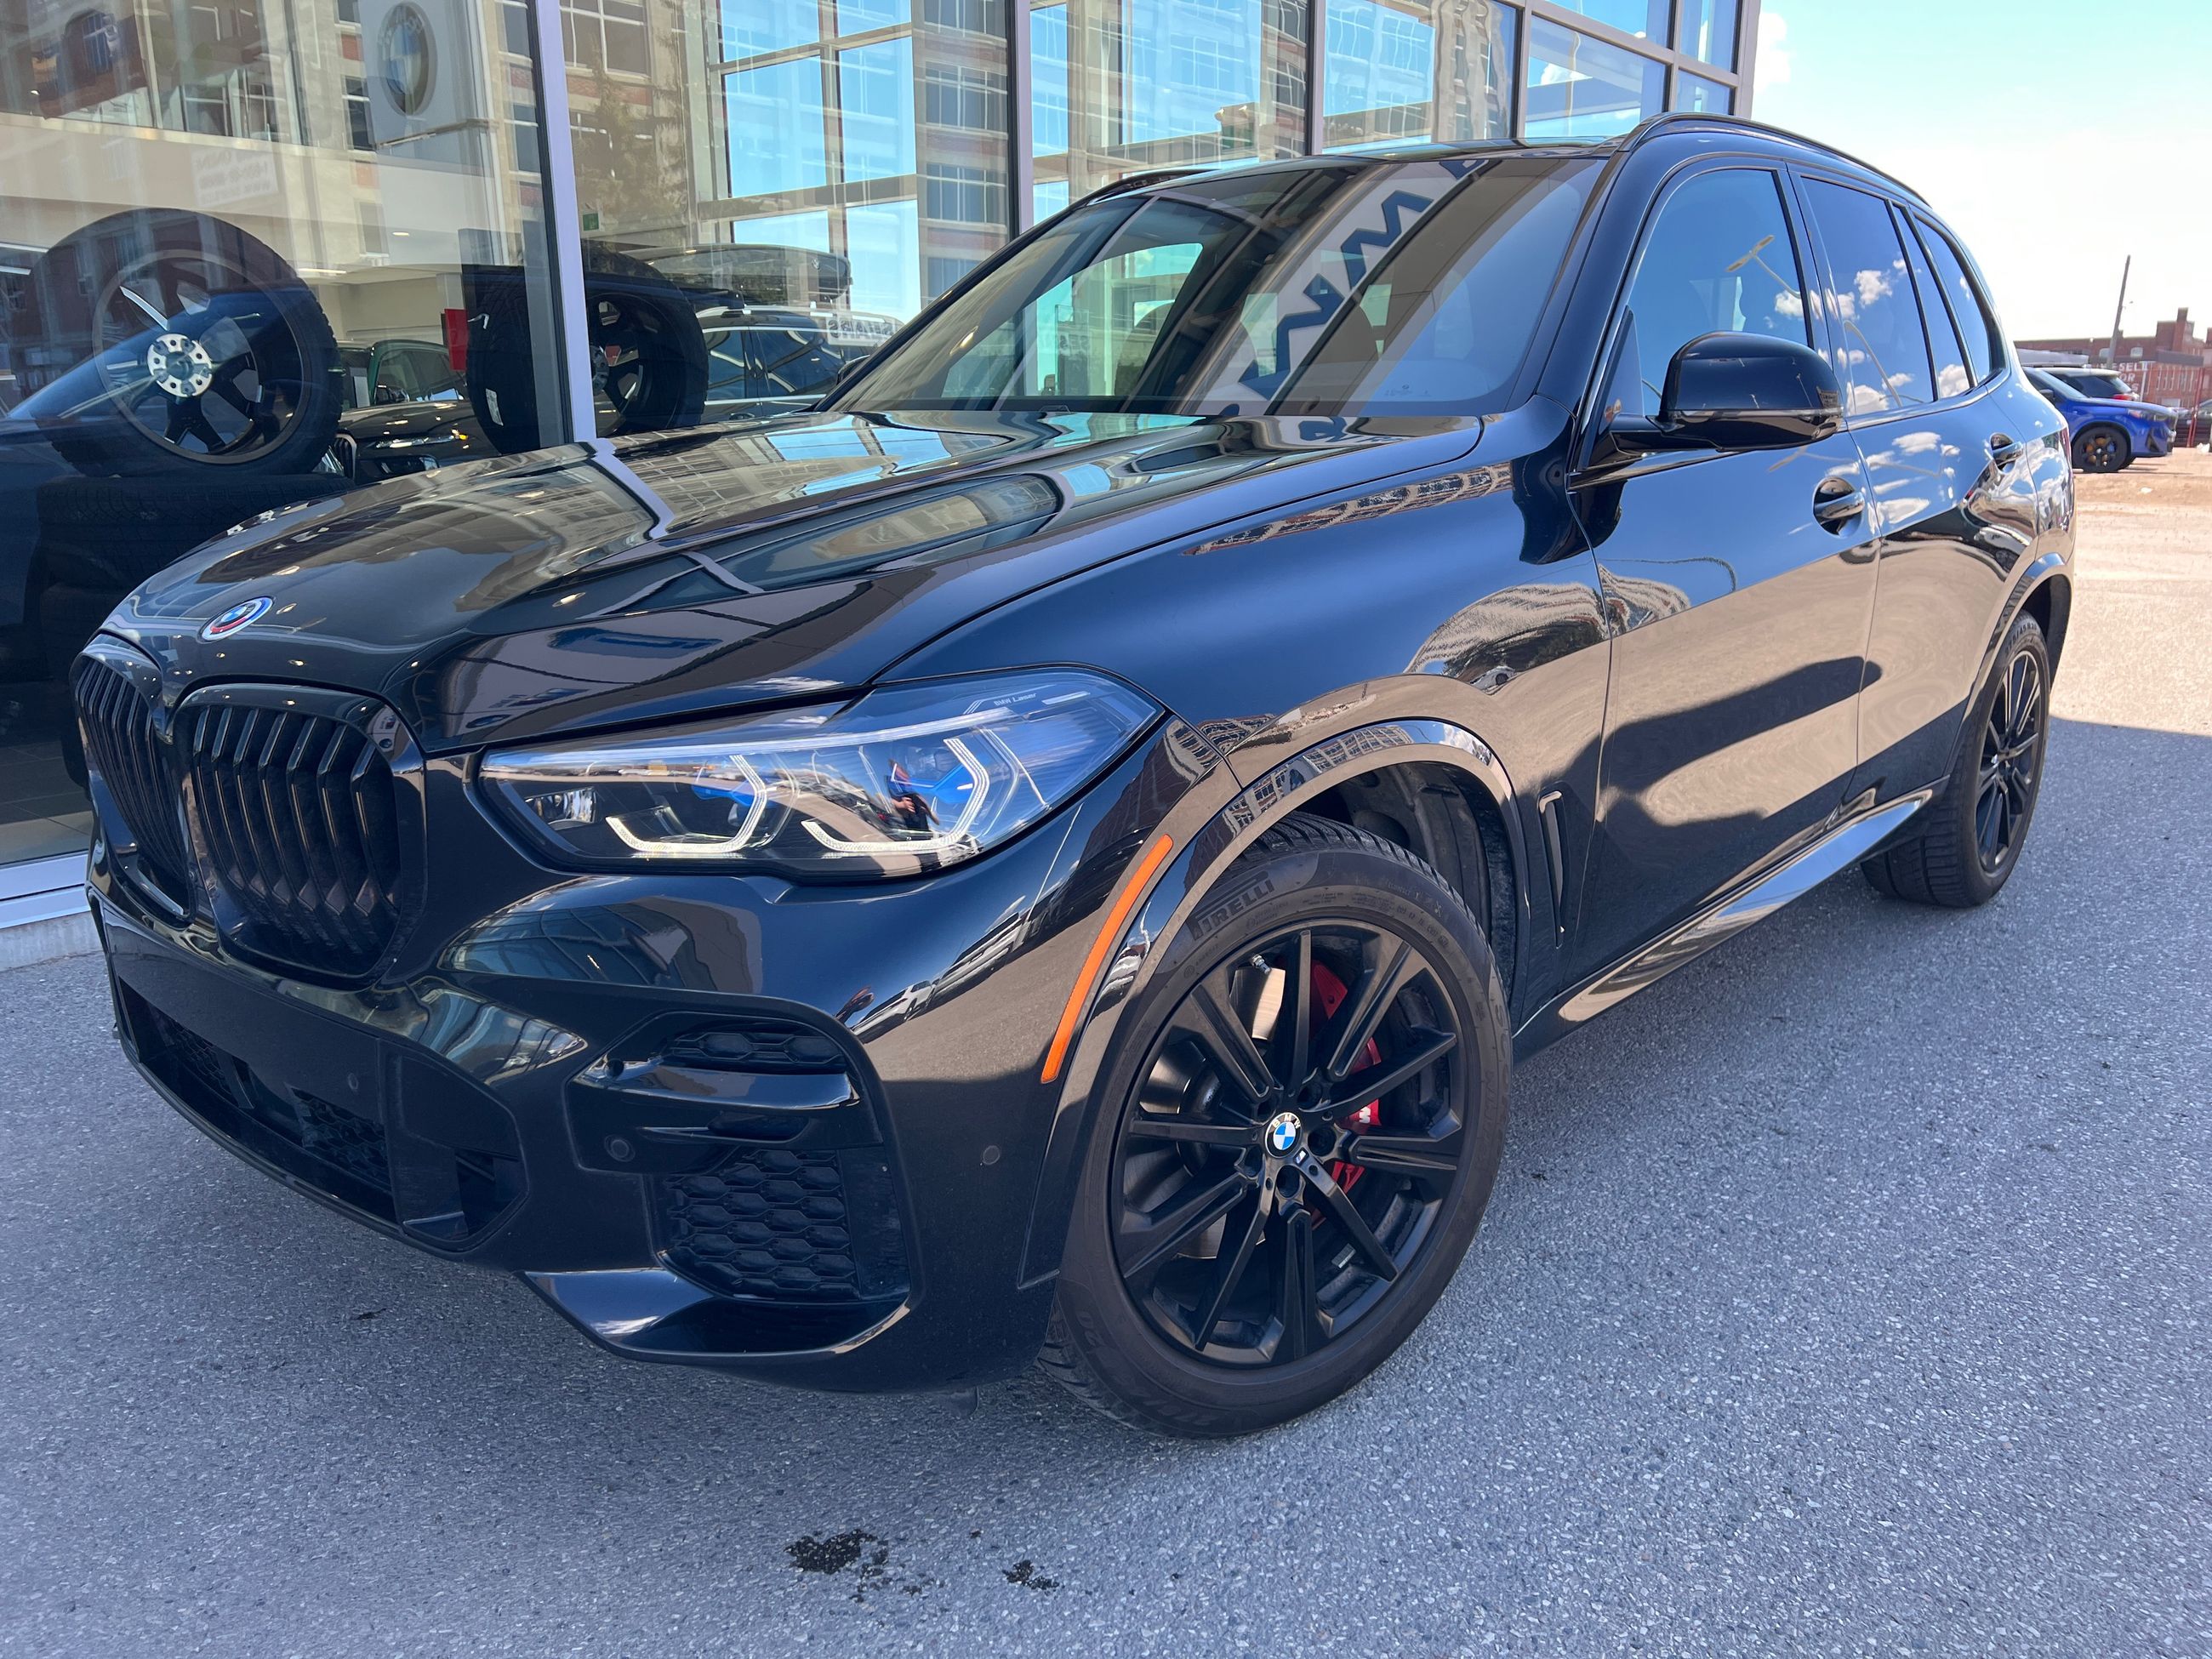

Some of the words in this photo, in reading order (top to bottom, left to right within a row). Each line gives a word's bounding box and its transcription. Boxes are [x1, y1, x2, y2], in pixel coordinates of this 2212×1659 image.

[993, 698, 1012, 706] BMW
[1012, 693, 1037, 703] Laser
[1188, 870, 1275, 941] PIRELLI
